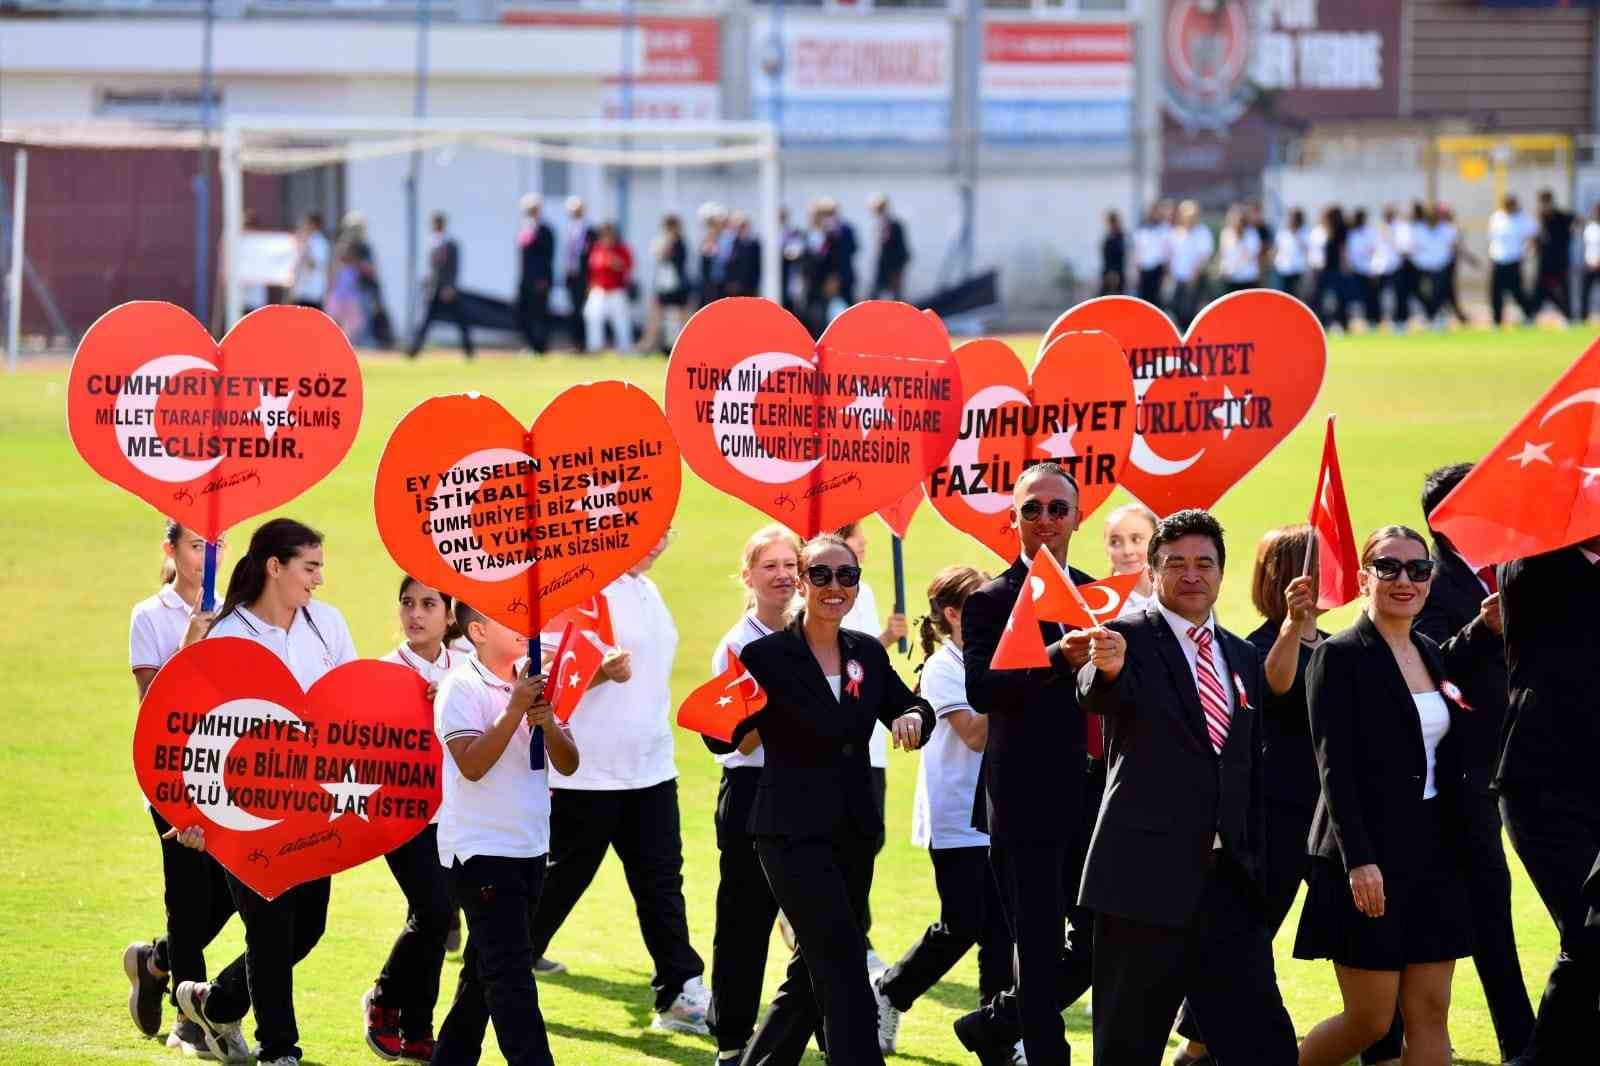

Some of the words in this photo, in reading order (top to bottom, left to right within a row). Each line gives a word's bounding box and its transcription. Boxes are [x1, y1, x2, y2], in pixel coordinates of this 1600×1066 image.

[1123, 338, 1255, 380] MHURİYET
[87, 371, 289, 397] CUMHURİYETTE
[298, 373, 347, 398] SÖZ
[686, 363, 732, 392] TÜRK
[738, 363, 831, 394] MİLLETİNİN
[837, 370, 951, 400] KARAKTERİNE
[96, 405, 153, 426] MİLLET
[160, 408, 261, 426] TARAFINDAN
[267, 407, 341, 429] SEÇİLMİŞ
[695, 400, 715, 424] VE
[719, 399, 812, 428] ADETLERİNE
[816, 405, 837, 429] EN
[842, 407, 893, 430] UYGUN
[898, 404, 942, 433] İDARE
[958, 397, 1126, 440] UMHURİYET
[1135, 388, 1273, 435] ÜRLÜKTÜR
[127, 432, 304, 459] MECLİSTEDİR.
[406, 475, 431, 493] EY
[438, 459, 542, 487] YÜKSELEN
[548, 446, 594, 471] YENİ
[600, 439, 662, 464] NESİL!
[720, 431, 821, 460] CUMHURİYET
[826, 433, 910, 464] İDARESİDİR
[415, 483, 528, 514] İSTİKBAL
[537, 464, 648, 495] SİZSİNİZ.
[930, 446, 1116, 498] FAZİLTİR
[421, 501, 541, 536] CUMHURİYETİ
[548, 495, 576, 517] BİZ
[581, 486, 653, 511] KURDUK
[438, 536, 483, 556] ONU
[491, 511, 639, 548] YÜKSELTECEK
[453, 558, 473, 574] VE
[477, 543, 563, 571] YAŞATACAK
[568, 533, 630, 556] SİZSİNİZ
[167, 711, 319, 747] CUMHURİYET;
[327, 720, 432, 752] DÜŞÜNCE
[155, 744, 221, 774] BEDEN
[227, 757, 247, 776] ve
[254, 747, 308, 779] BİLİM
[314, 759, 436, 789] BAKIMINDAN
[155, 778, 221, 809] GÜÇLÜ
[226, 789, 369, 816] KORUYUCULAR
[375, 793, 429, 820] İSTER
